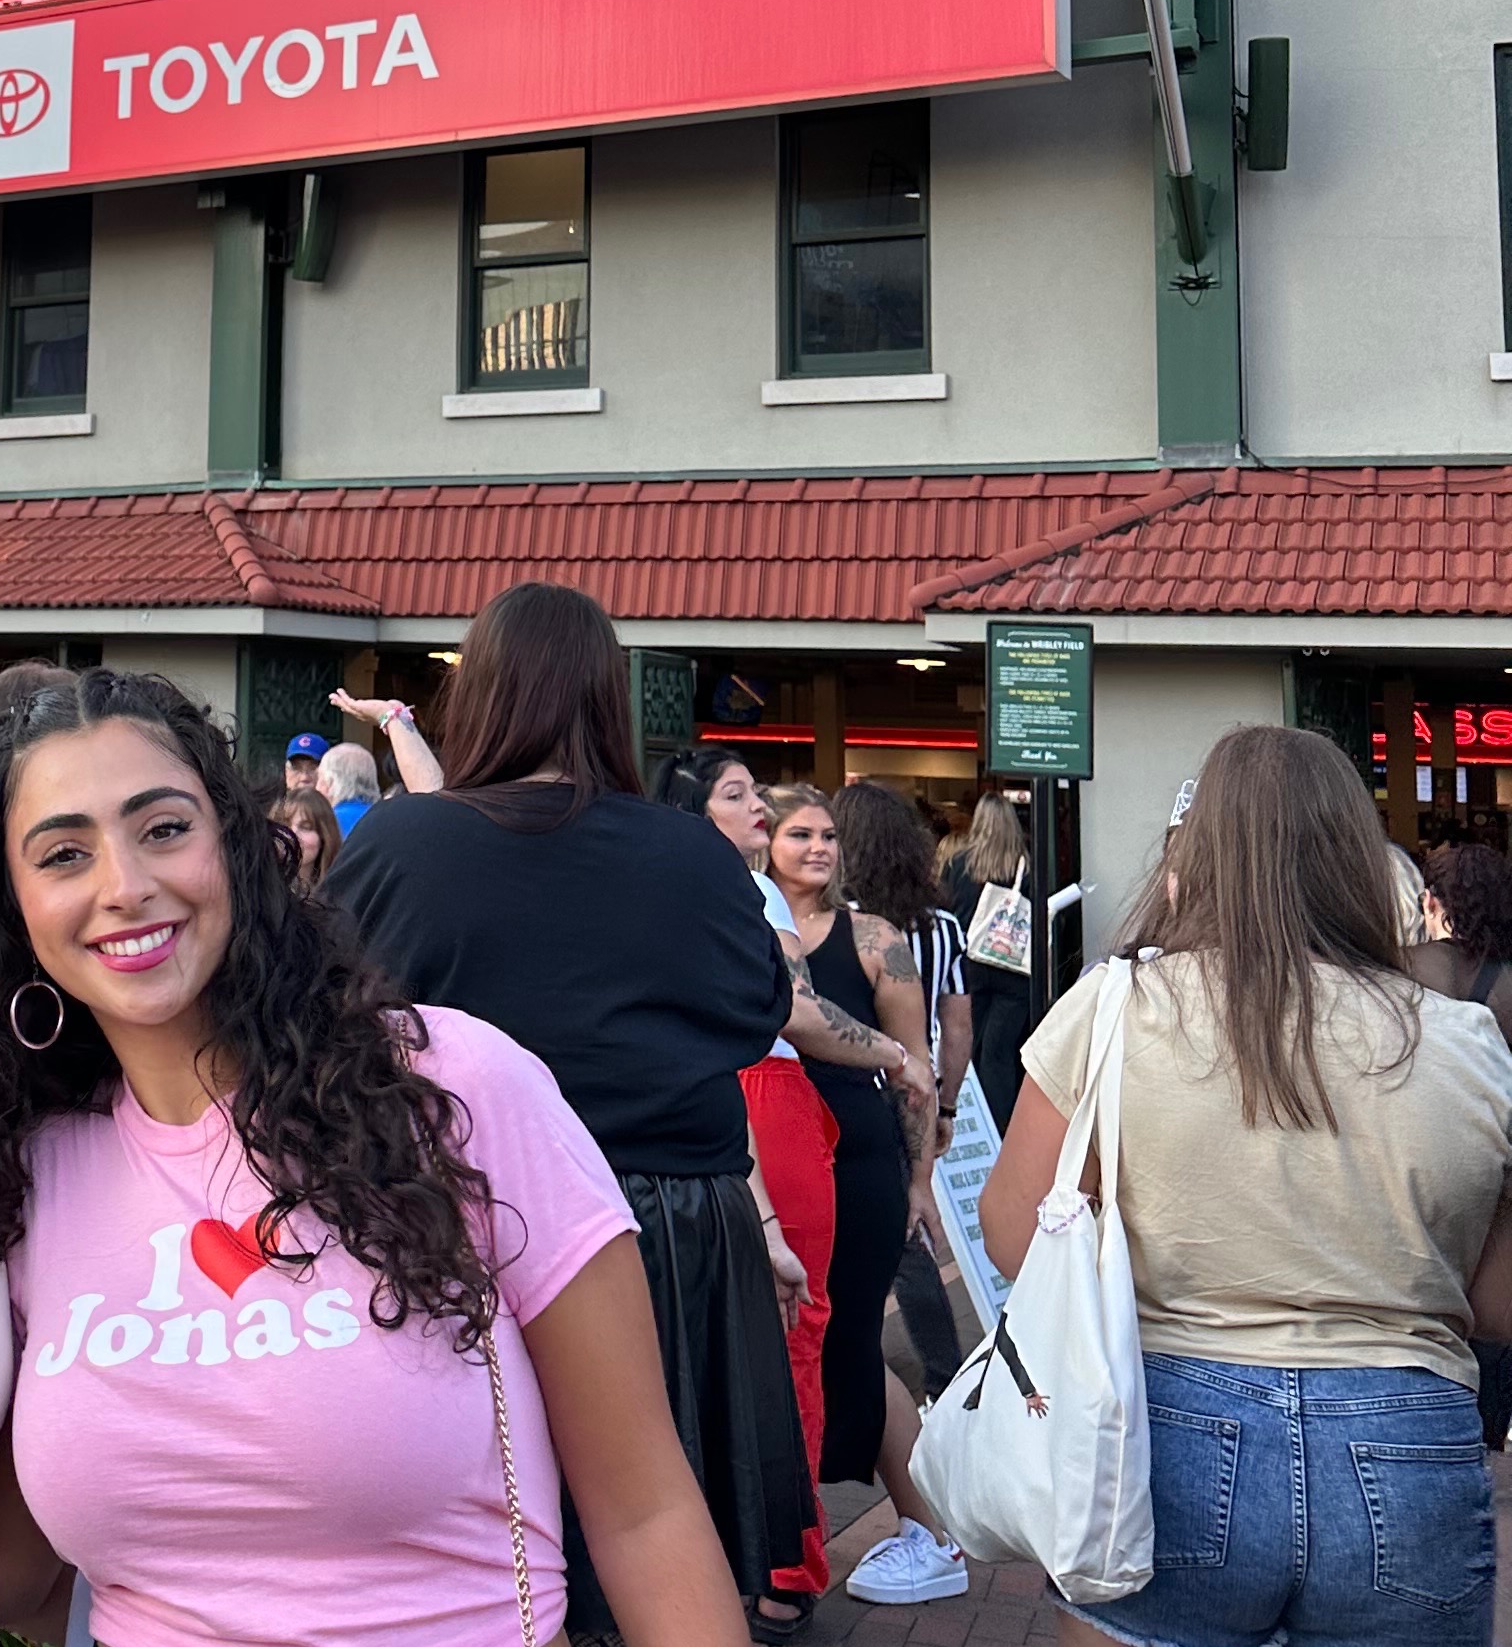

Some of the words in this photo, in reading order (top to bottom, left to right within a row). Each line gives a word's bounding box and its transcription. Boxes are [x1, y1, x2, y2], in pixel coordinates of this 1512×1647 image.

[103, 13, 440, 120] TOYOTA
[136, 1223, 187, 1311] I
[35, 1287, 360, 1377] Jonas
